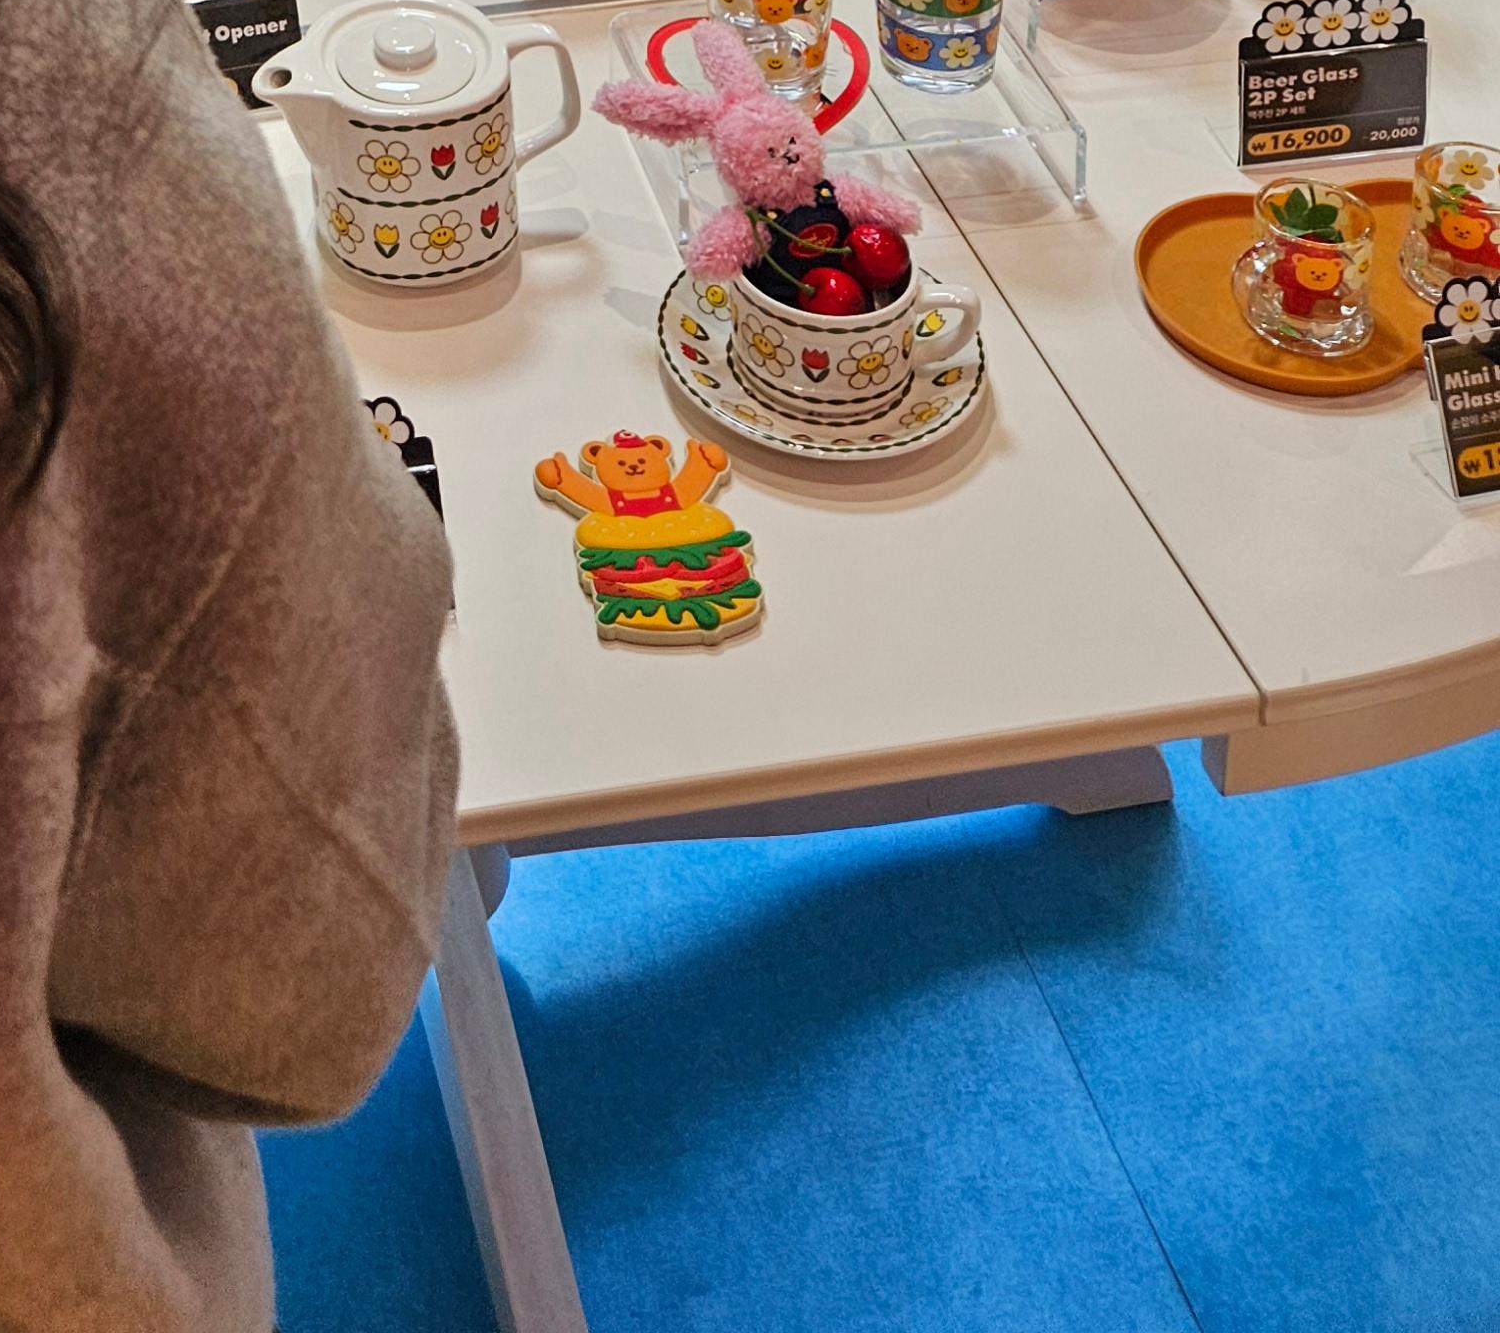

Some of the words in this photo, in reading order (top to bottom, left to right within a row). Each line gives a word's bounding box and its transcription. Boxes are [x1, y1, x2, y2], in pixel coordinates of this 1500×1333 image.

[214, 18, 288, 45] Opener
[1248, 73, 1298, 90] Beer
[1302, 66, 1359, 85] Glass
[1248, 90, 1278, 107] 2P
[1282, 86, 1317, 103] Set
[1444, 365, 1491, 391] Mini
[1447, 391, 1500, 411] Glass
